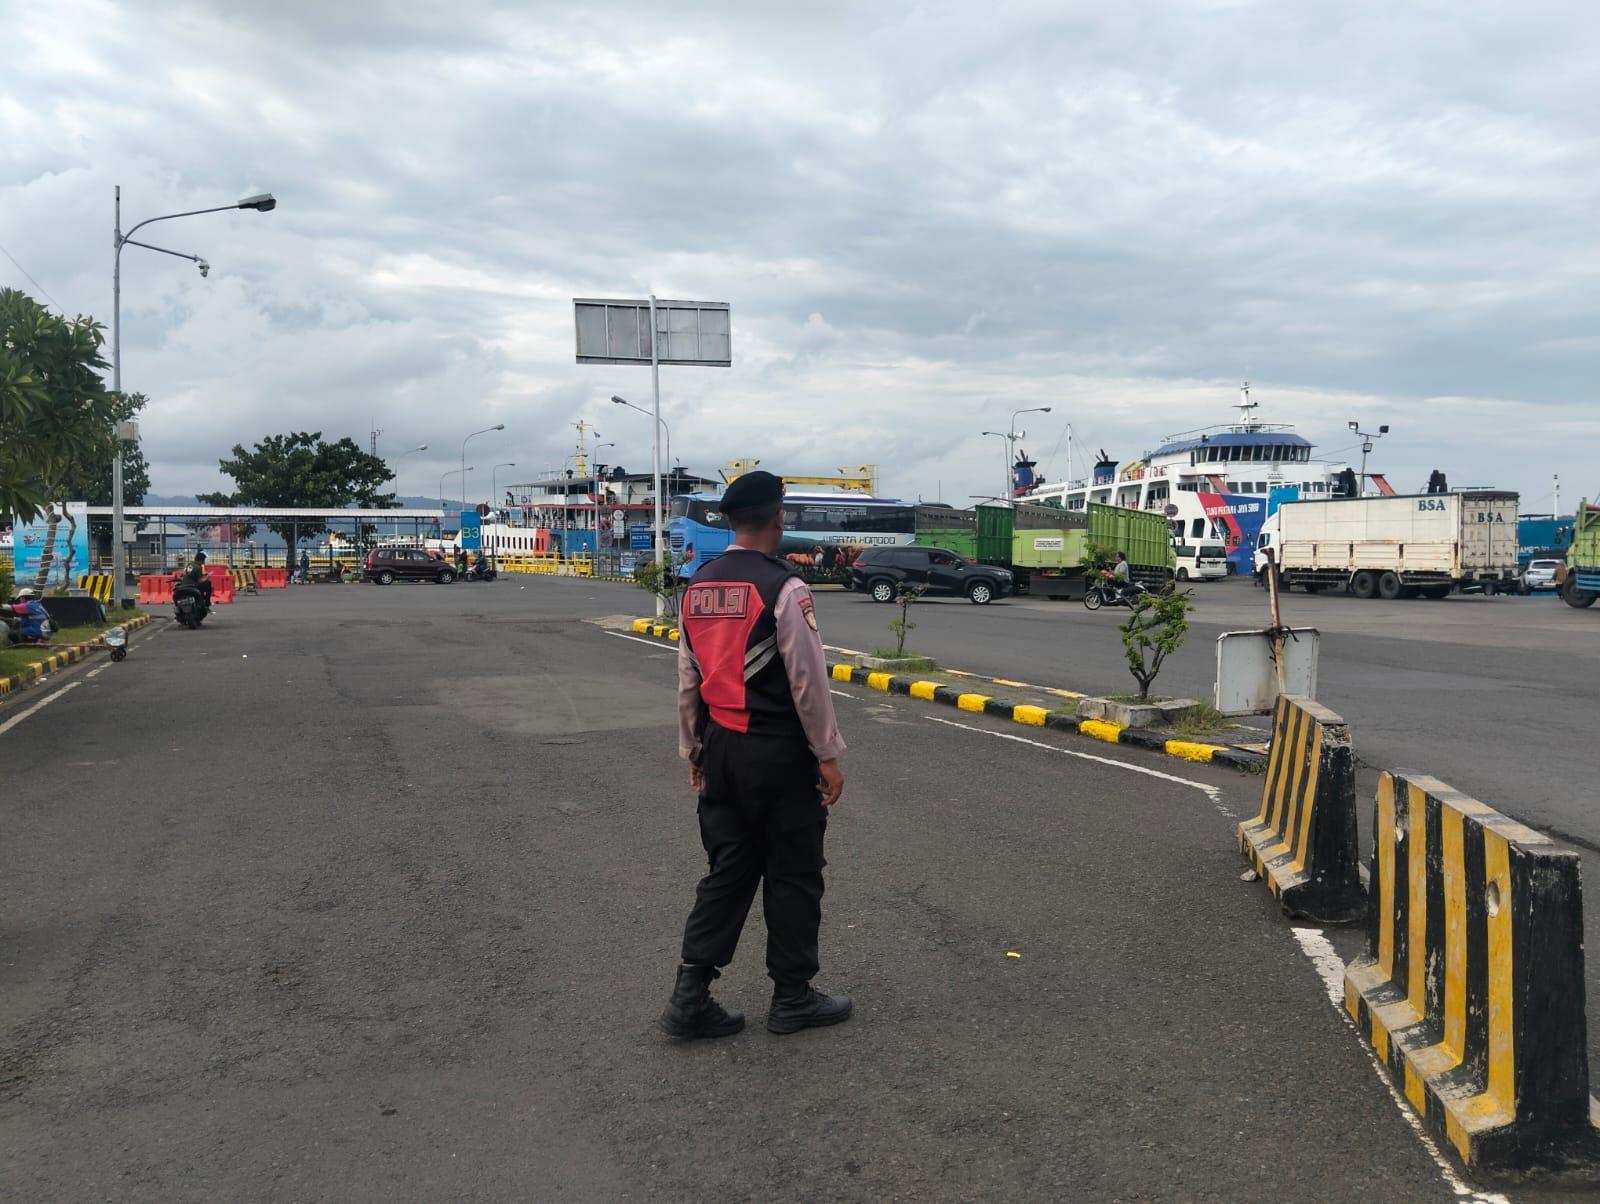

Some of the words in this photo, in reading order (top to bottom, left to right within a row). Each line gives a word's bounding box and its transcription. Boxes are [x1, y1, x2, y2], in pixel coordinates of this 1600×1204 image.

[1418, 499, 1446, 511] BSA
[462, 527, 480, 539] B3
[823, 535, 857, 545] WISATA
[689, 587, 746, 614] POLISI
